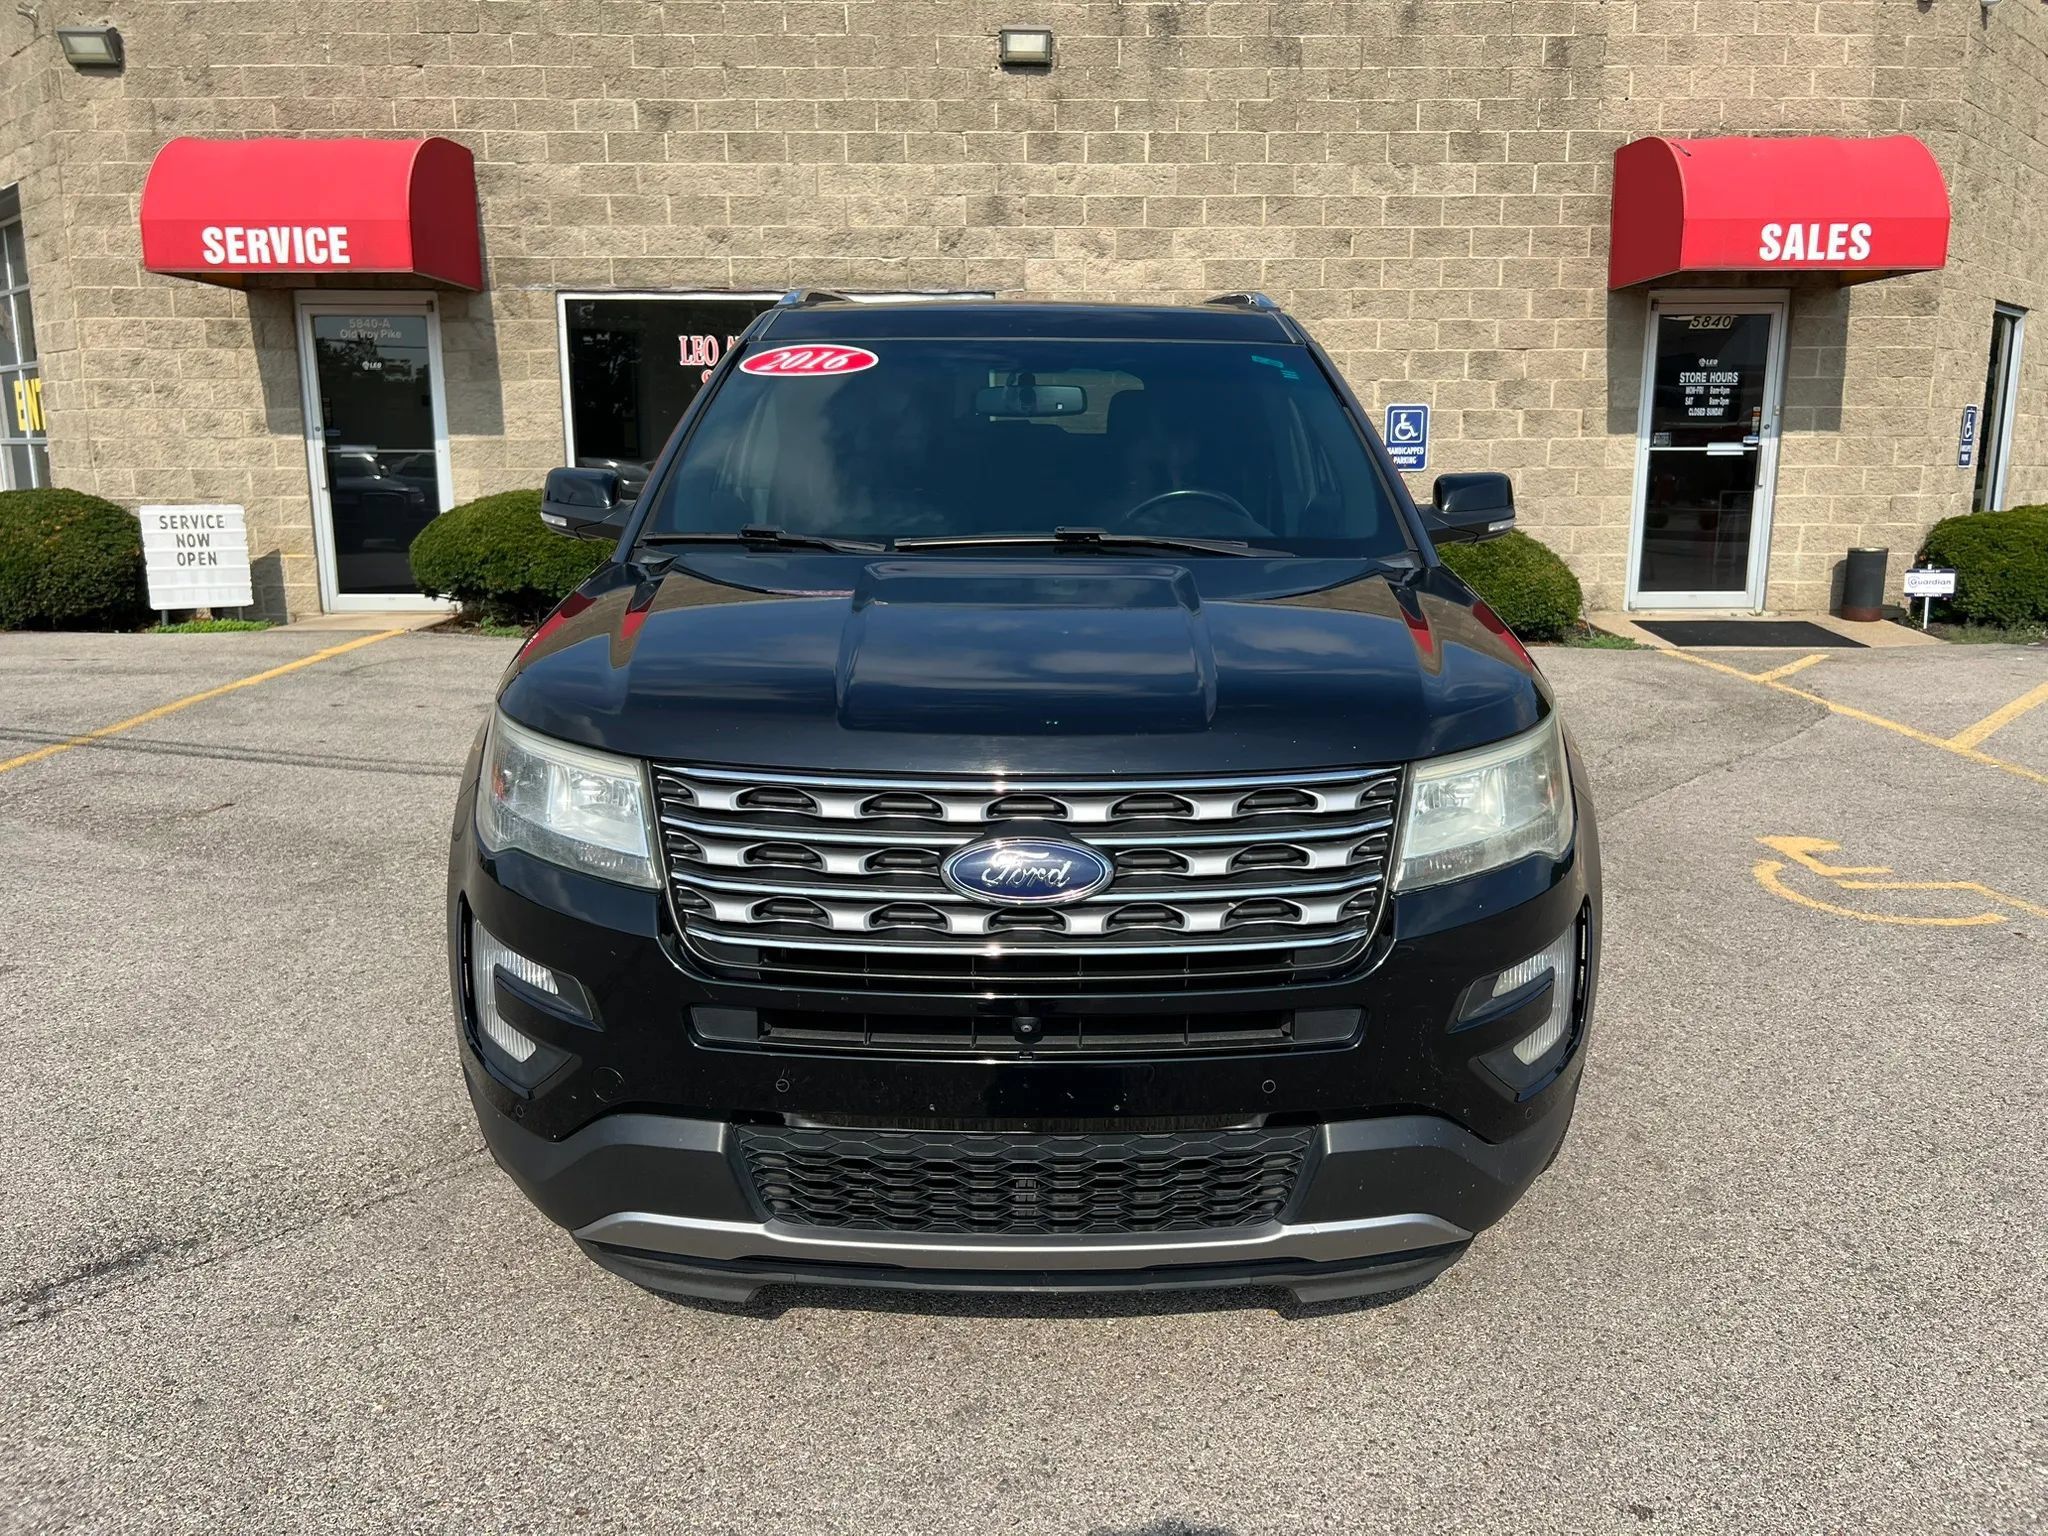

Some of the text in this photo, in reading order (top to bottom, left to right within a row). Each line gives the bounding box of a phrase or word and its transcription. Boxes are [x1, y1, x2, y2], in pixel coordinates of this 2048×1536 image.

[201, 225, 351, 265] SERVICE
[1759, 222, 1873, 261] SALES
[349, 319, 391, 328] 5840-A
[1691, 315, 1732, 328] 5840
[340, 329, 402, 341] Old Troy Pike
[678, 335, 719, 366] LEO
[757, 350, 861, 371] 2016
[1679, 372, 1739, 383] STORE HOURS
[1684, 396, 1694, 405] SAT
[1688, 407, 1724, 416] CLOSED SUNDAY
[1393, 456, 1417, 465] PARKING
[159, 514, 225, 530] SERVICE
[175, 533, 210, 548] NOW
[176, 551, 218, 566] OPEN
[1909, 578, 1952, 586] Guardian
[981, 850, 1072, 888] Ford
